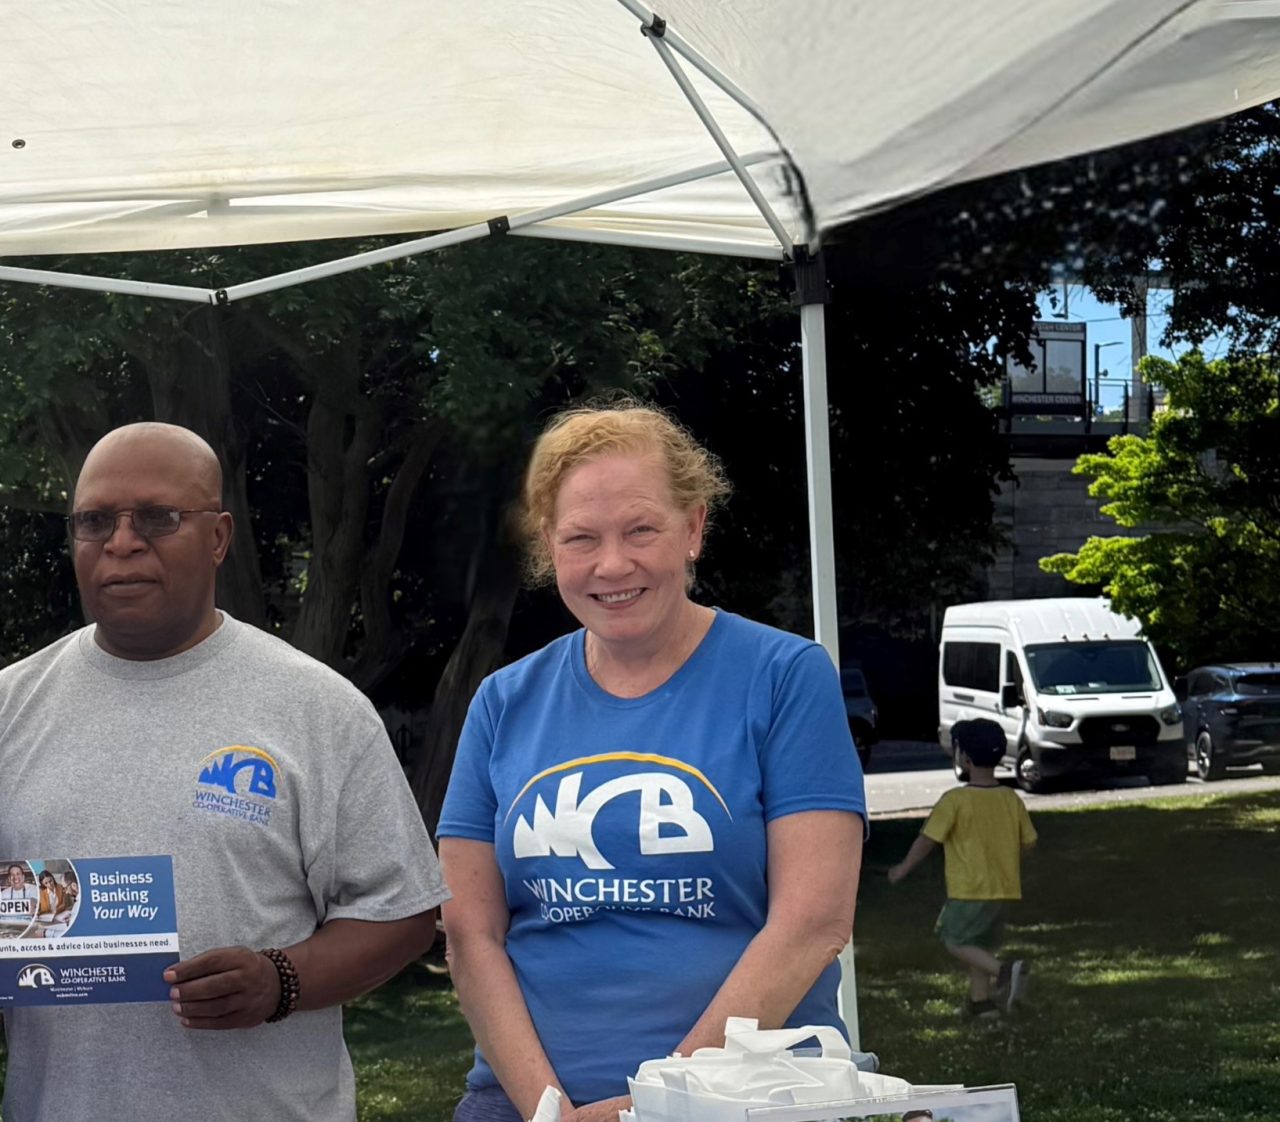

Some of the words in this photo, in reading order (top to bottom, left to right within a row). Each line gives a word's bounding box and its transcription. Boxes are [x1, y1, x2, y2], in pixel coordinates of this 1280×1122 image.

[195, 790, 272, 816] WINCHESTER
[89, 871, 153, 886] Business
[91, 888, 149, 904] Banking
[523, 878, 714, 903] WINCHESTER
[1, 901, 29, 913] OPEN
[93, 905, 125, 920] Your
[127, 904, 158, 921] Way
[21, 944, 47, 952] access
[48, 943, 55, 951] &
[56, 941, 82, 950] advice
[83, 940, 102, 950] local
[104, 939, 148, 949] businesses
[60, 966, 126, 978] WINCHESTER
[60, 976, 107, 984] CO-OPERATIVE
[108, 975, 126, 983] BANK
